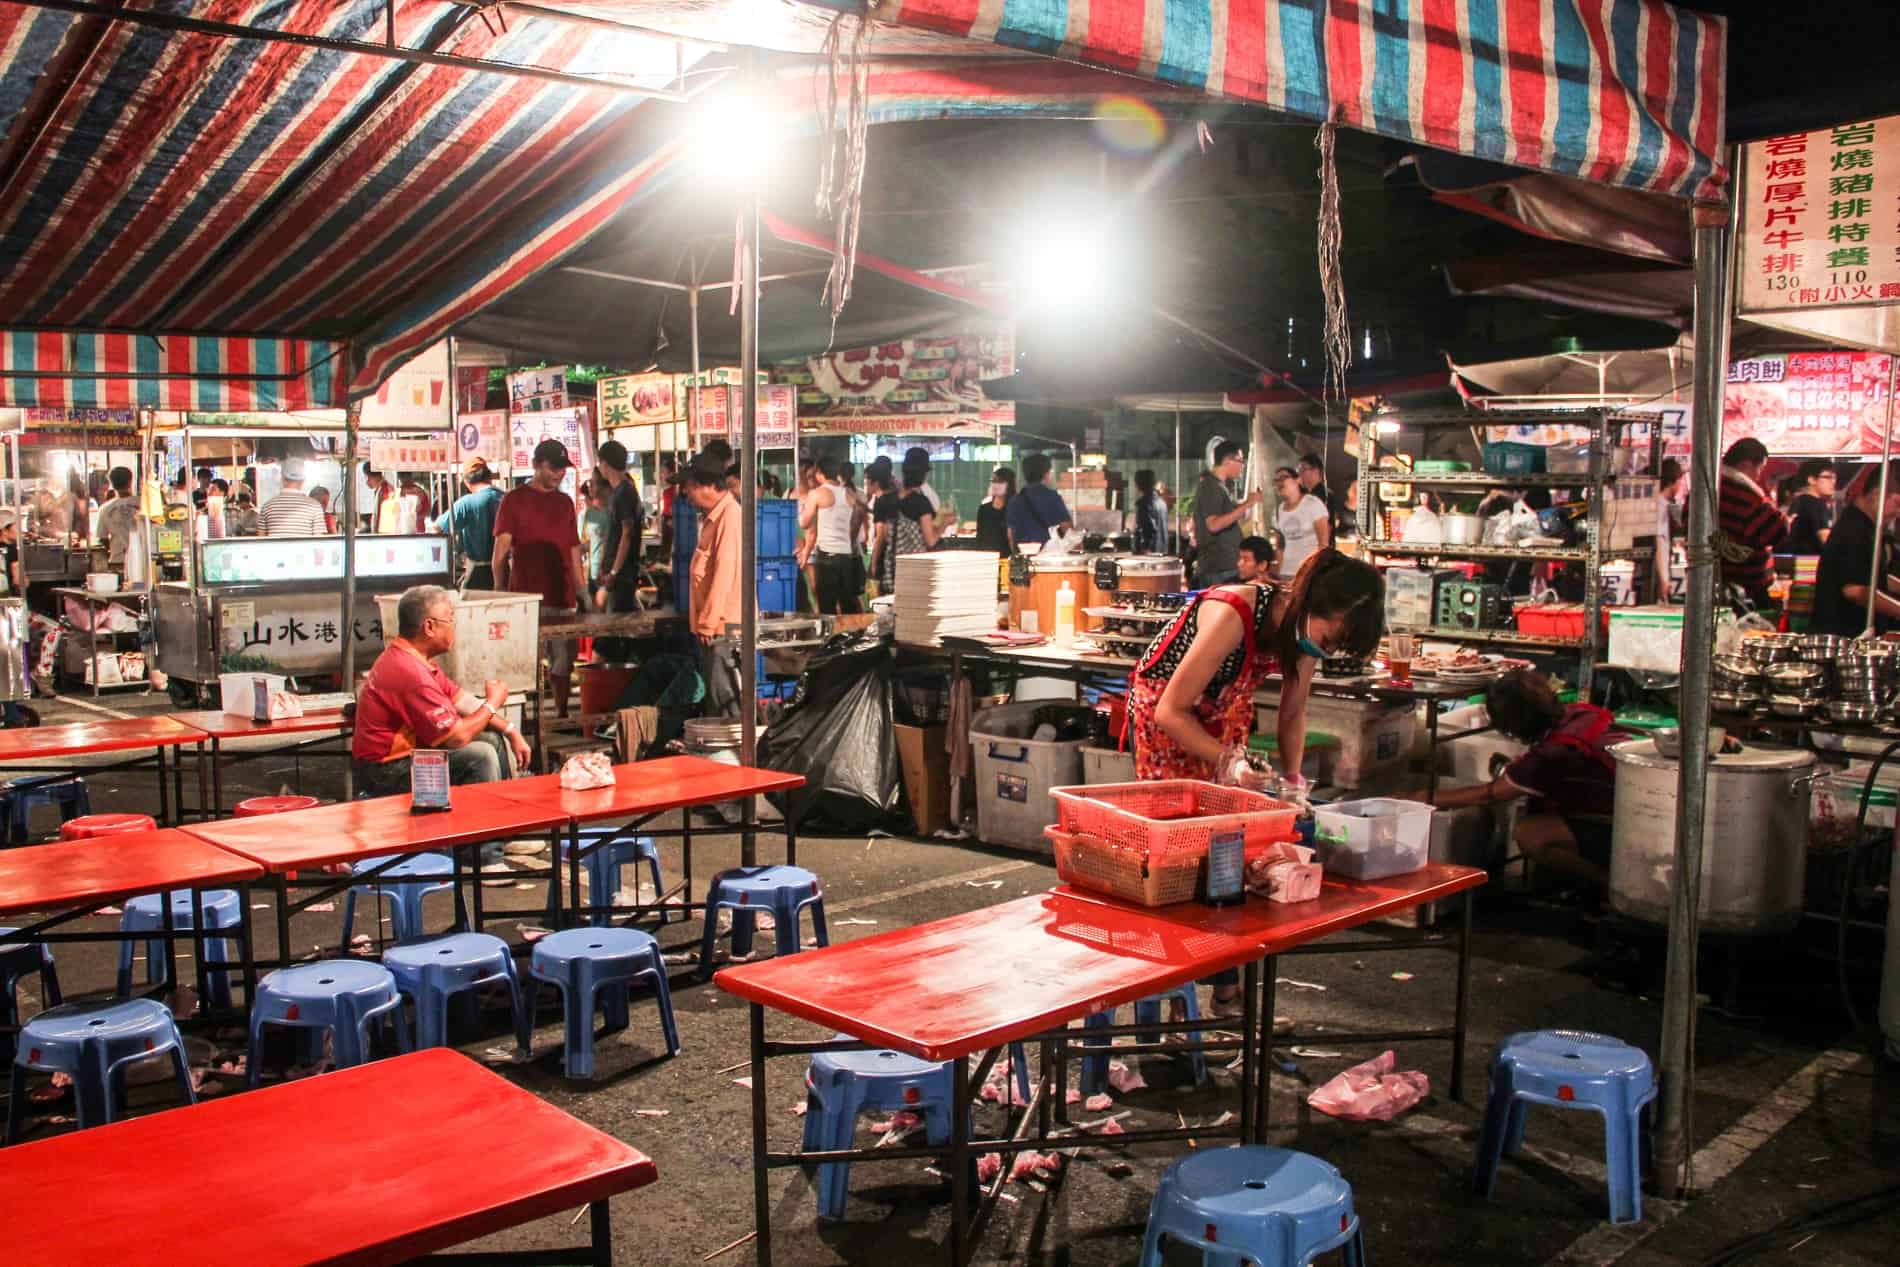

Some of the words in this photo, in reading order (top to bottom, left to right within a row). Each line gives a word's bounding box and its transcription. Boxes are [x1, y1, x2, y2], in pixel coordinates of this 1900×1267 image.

[1761, 132, 1808, 275] 岩燒厚片牛排
[1766, 274, 1800, 291] 130
[1831, 270, 1867, 285] 110
[604, 379, 631, 425] 玉米
